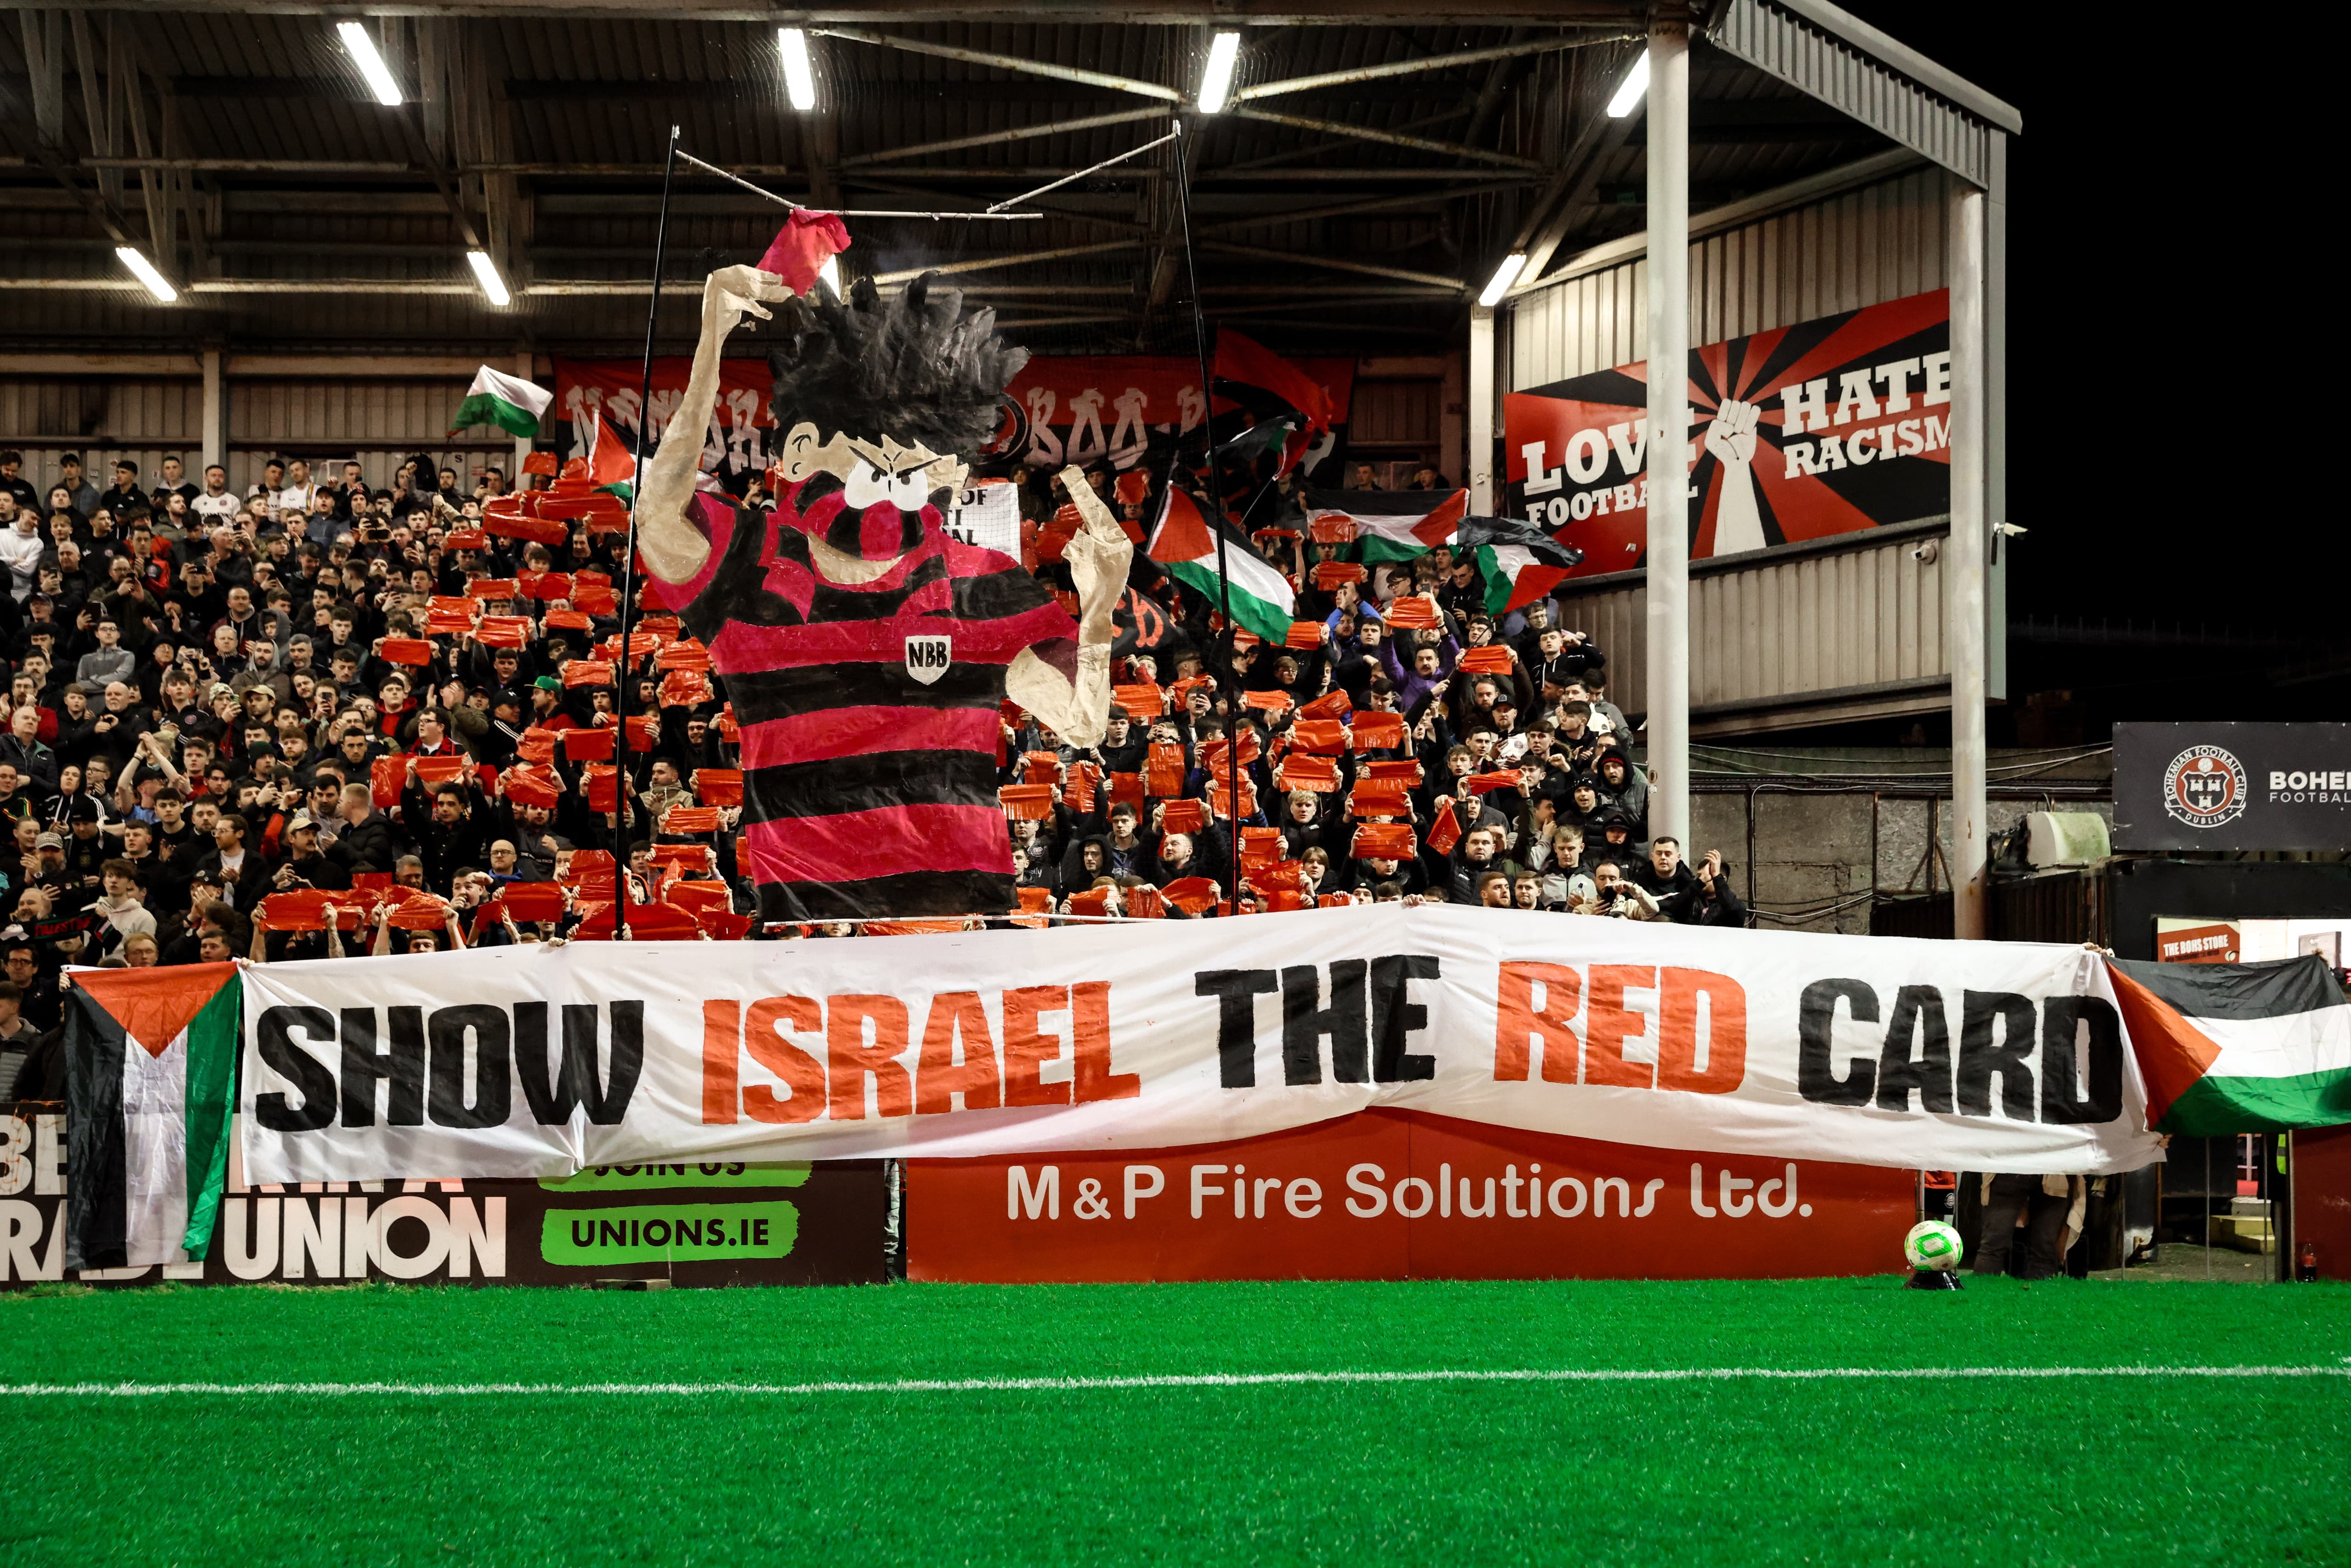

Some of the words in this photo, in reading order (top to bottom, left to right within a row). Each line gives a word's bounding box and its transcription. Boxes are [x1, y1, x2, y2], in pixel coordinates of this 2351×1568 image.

[1781, 350, 1950, 437] HATE
[1522, 408, 1696, 495] LOV
[1783, 412, 1950, 479] RACISM
[909, 642, 947, 668] NBB
[2166, 751, 2193, 800] BOHEMIAN
[2195, 747, 2240, 774] FOOTBALL
[2234, 776, 2245, 801] CLUB
[2185, 813, 2226, 824] DUBLIN
[2163, 942, 2179, 957] THE
[2180, 938, 2203, 954] BOHS
[2203, 934, 2228, 950] STORE
[256, 1000, 644, 1131] SHOW
[701, 981, 1141, 1125] ISRAEL
[1195, 955, 1439, 1089] THE
[1493, 961, 1747, 1095] RED
[1799, 978, 2125, 1124] CARD
[1008, 1166, 1059, 1220] M
[1073, 1178, 1111, 1220] &
[1124, 1165, 1165, 1220] P
[1191, 1164, 1322, 1219] Fire
[1345, 1163, 1665, 1219] Solutions
[224, 1196, 506, 1280] UNION
[572, 1219, 769, 1247] UNIONS.IE
